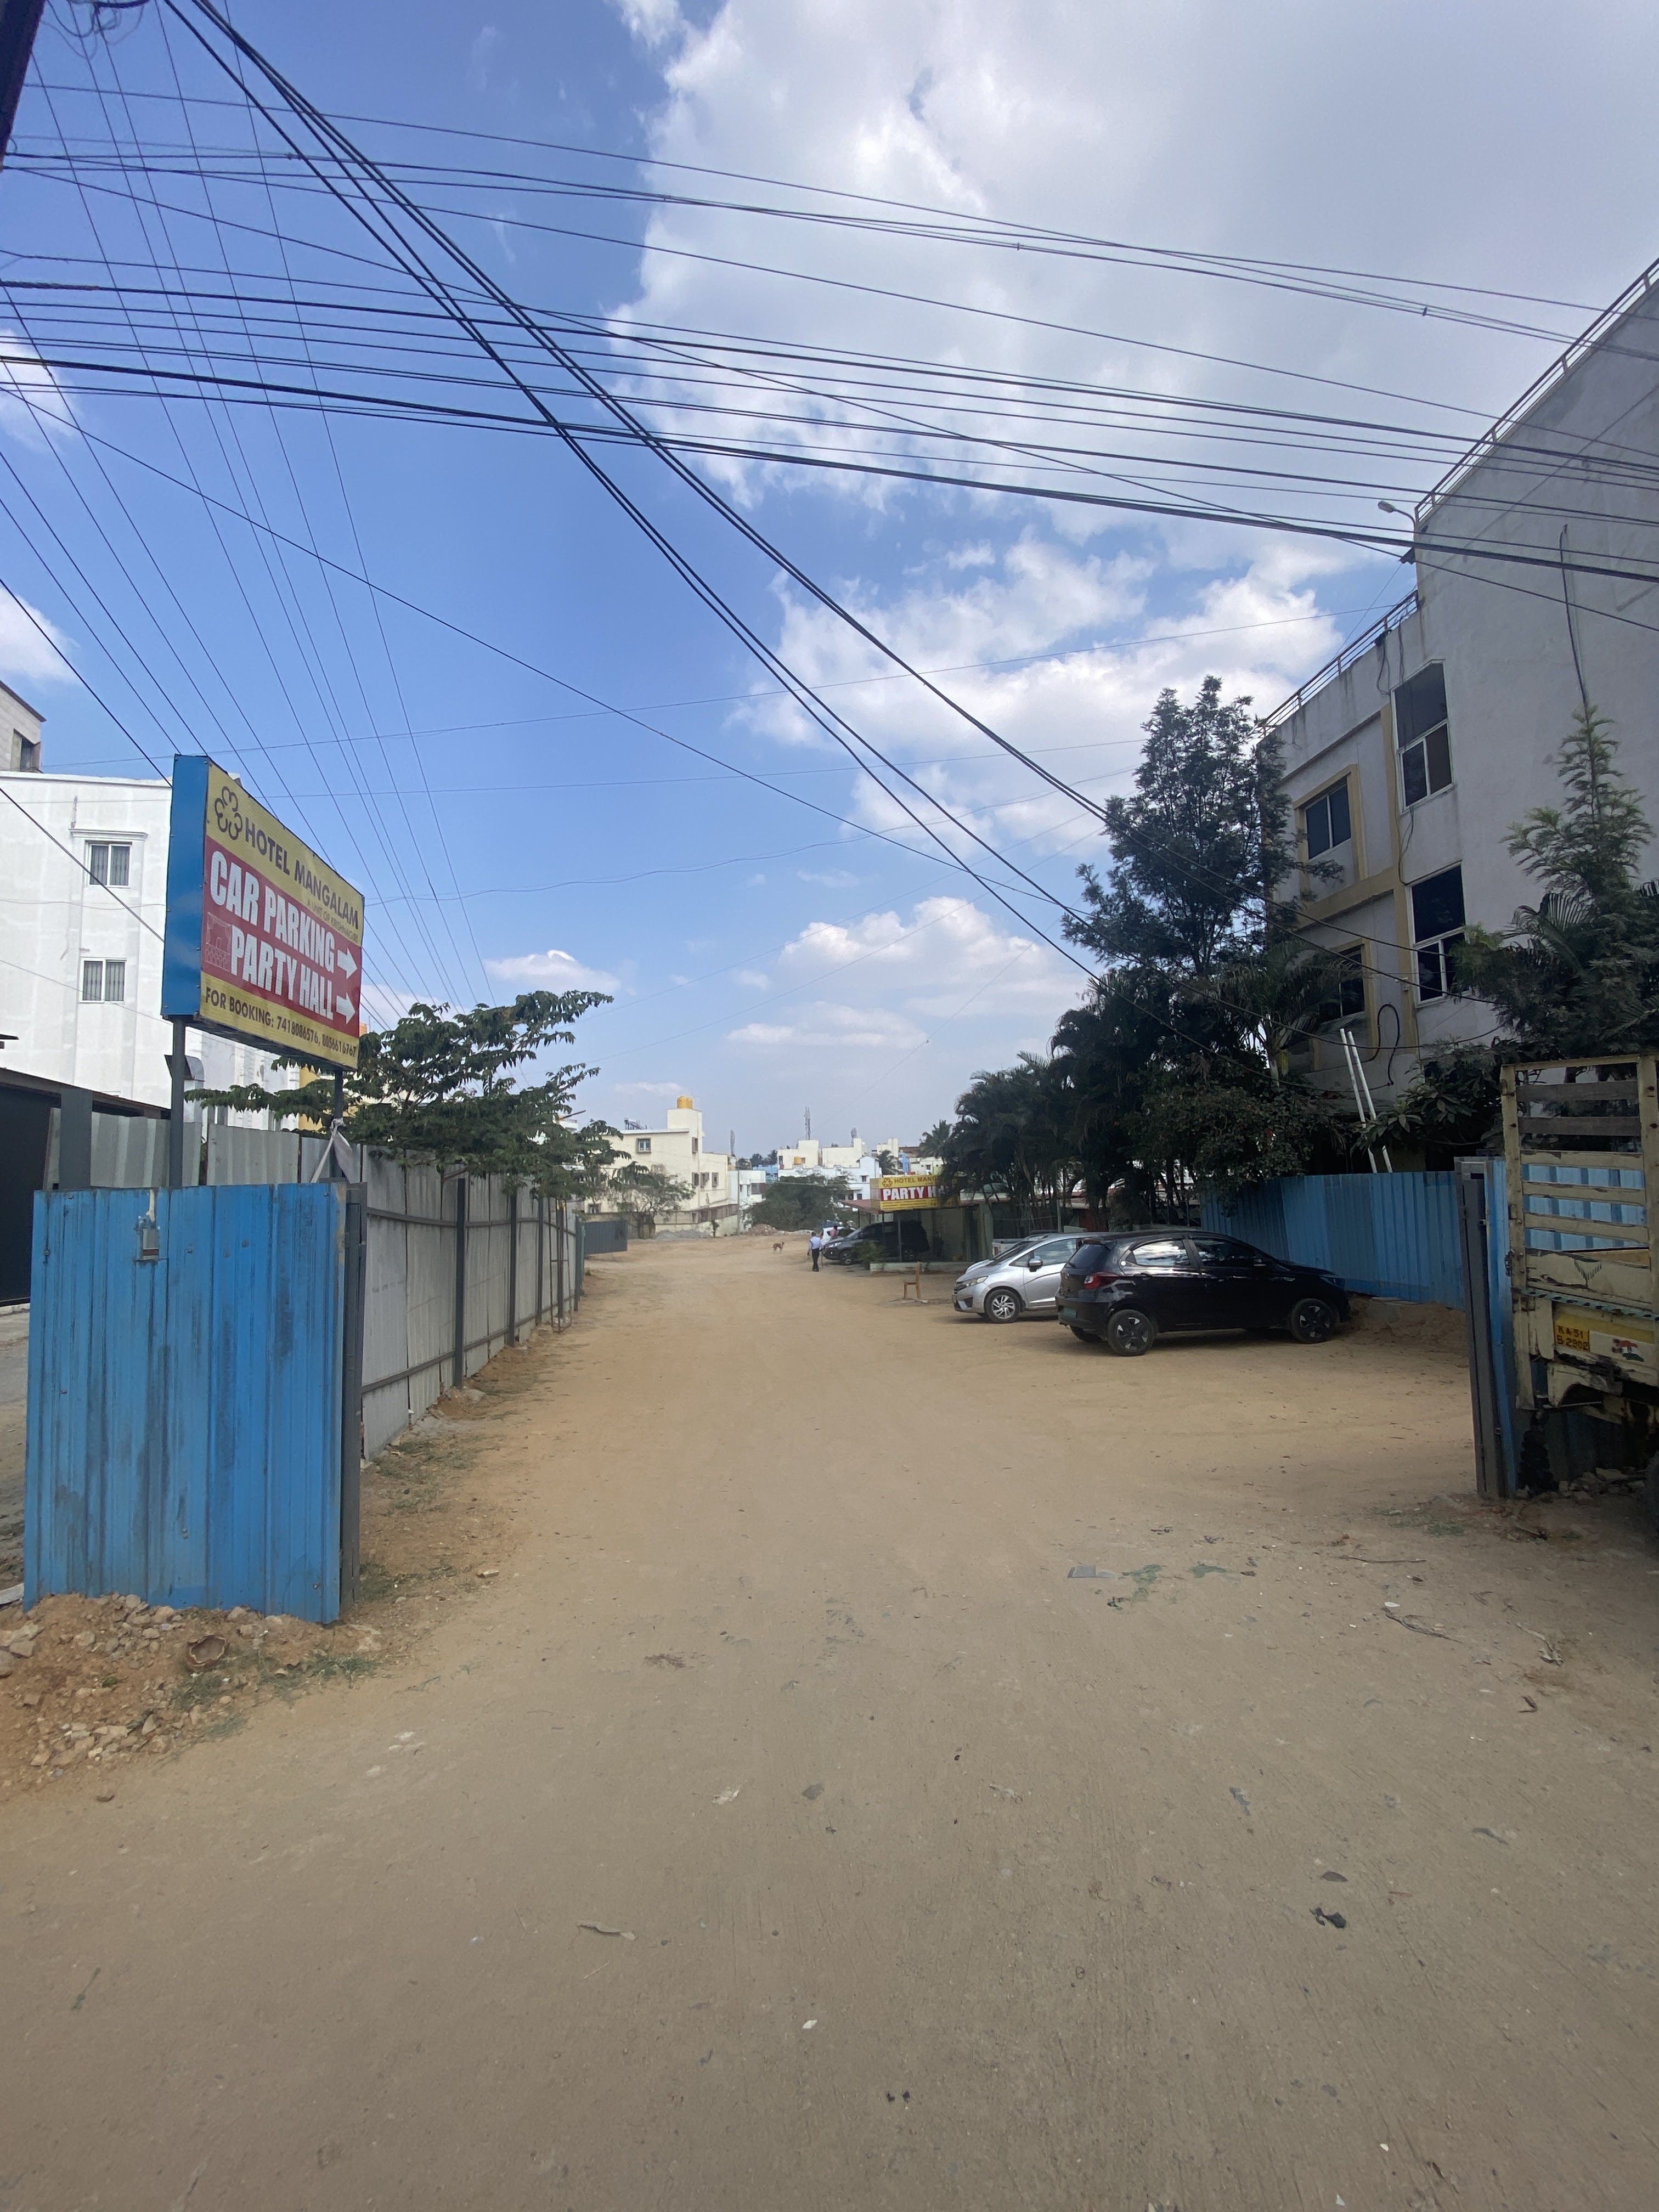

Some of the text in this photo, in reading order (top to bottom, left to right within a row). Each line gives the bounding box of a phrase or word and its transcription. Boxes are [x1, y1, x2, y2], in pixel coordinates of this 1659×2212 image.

[210, 850, 336, 973] CAR PARKING
[245, 817, 359, 930] HOTEL MANGALAM
[205, 987, 226, 1010] FOR
[229, 996, 274, 1028] BOOKING:
[230, 924, 334, 1022] PARTY HALL
[883, 1186, 925, 1201] PARTY
